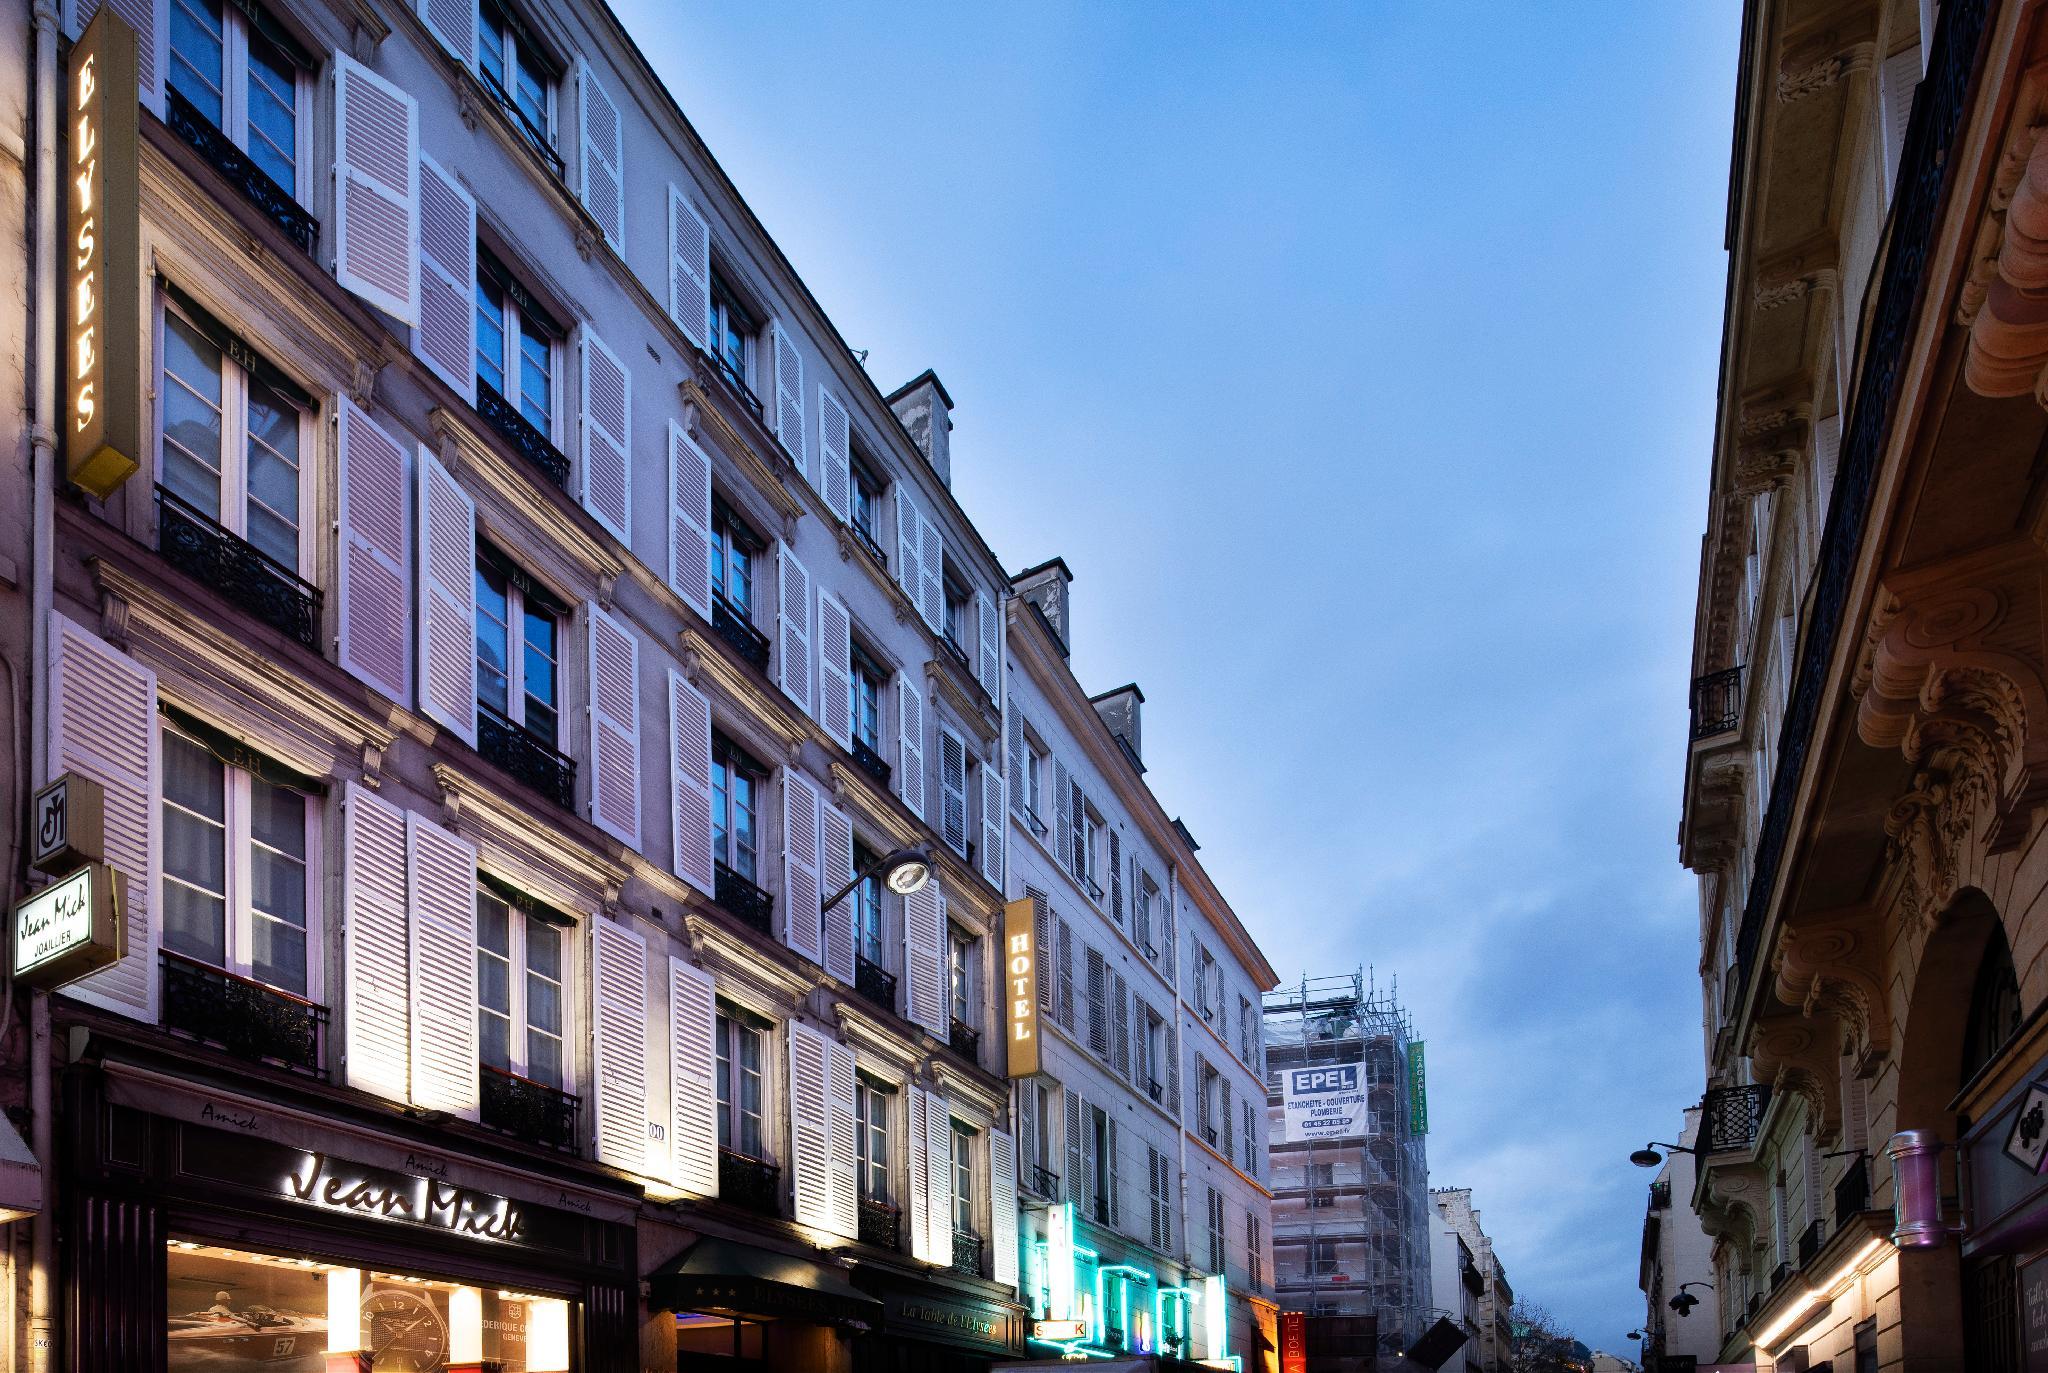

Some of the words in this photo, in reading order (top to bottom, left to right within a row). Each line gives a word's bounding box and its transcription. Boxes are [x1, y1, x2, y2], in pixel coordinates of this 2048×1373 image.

[77, 54, 96, 433] ELYSEES
[230, 339, 256, 372] EH
[21, 913, 51, 941] Jean
[54, 883, 86, 925] Mick
[34, 929, 71, 958] JOAILLIER
[1010, 933, 1030, 1041] HOTEL
[1296, 1069, 1354, 1091] EPEL
[1310, 1107, 1343, 1117] PLOMBERIE
[290, 1151, 413, 1215] Jean
[424, 1177, 525, 1241] Mick
[393, 1300, 405, 1310] 12
[277, 1339, 294, 1354] 57
